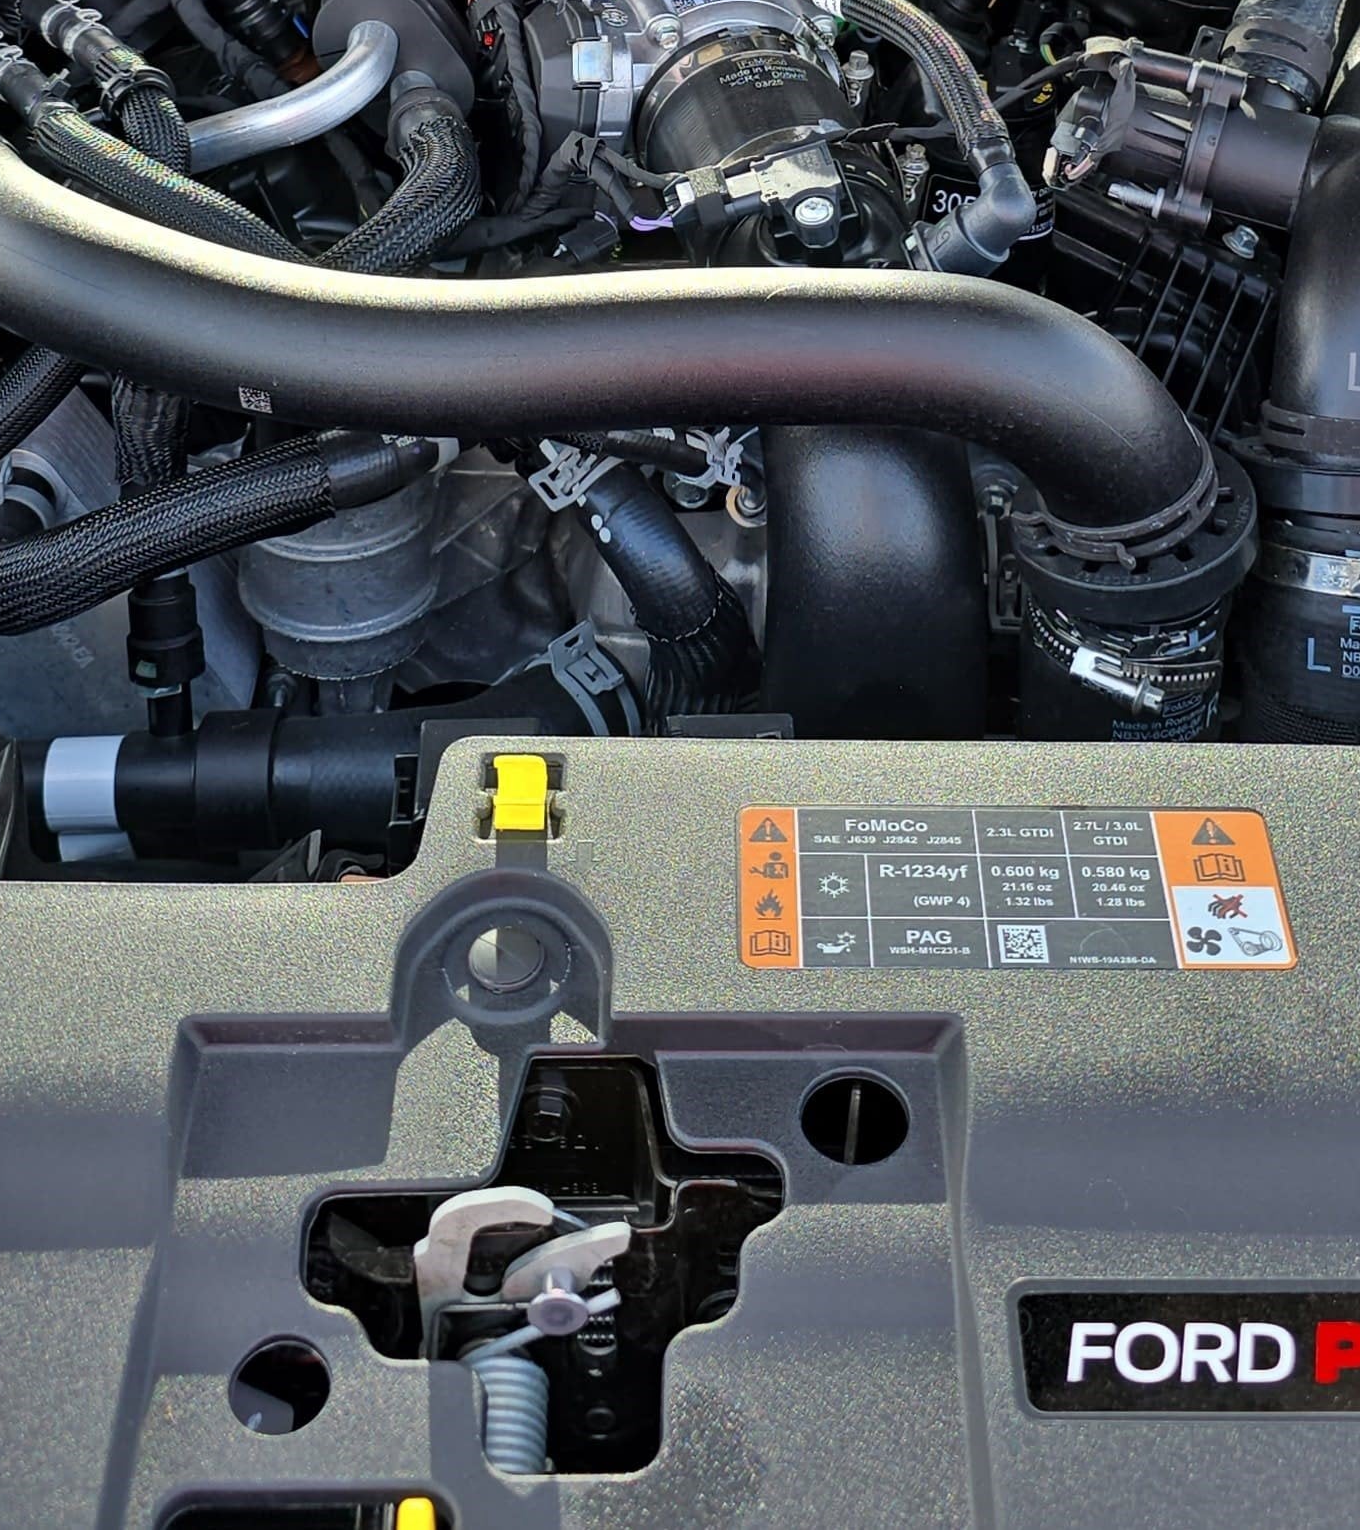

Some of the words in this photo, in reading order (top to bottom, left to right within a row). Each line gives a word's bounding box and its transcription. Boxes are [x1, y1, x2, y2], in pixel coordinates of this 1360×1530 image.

[719, 68, 751, 85] Made
[1307, 637, 1332, 672] L
[1112, 719, 1149, 730] Made
[844, 818, 928, 833] FoMoCo
[1073, 821, 1103, 831] 2.7L
[1113, 821, 1144, 831] 3.0L
[986, 827, 1016, 838] 2.3L
[1019, 828, 1055, 838] GTDI
[813, 835, 841, 844] SAE
[847, 835, 877, 844] J639
[882, 835, 918, 845] J2842
[926, 836, 962, 846] J2845
[1093, 836, 1129, 846] GTDI
[879, 863, 969, 882] R-1234yf
[990, 865, 1035, 877] 0.600
[1039, 865, 1061, 880] kg
[1081, 866, 1126, 878] 0.580
[1130, 866, 1151, 880] kg
[1002, 882, 1035, 892] 21.16
[1037, 884, 1053, 892] oz
[1092, 883, 1126, 893] 20.46
[1129, 884, 1146, 893] oz
[913, 895, 954, 908] (GWP
[956, 895, 971, 908] 4)
[1005, 897, 1032, 907] 1.32
[1033, 897, 1054, 907] lbs
[1096, 897, 1123, 907] 1.28
[1125, 897, 1146, 907] lbs
[905, 929, 953, 945] PAG
[1066, 1320, 1296, 1384] FORD
